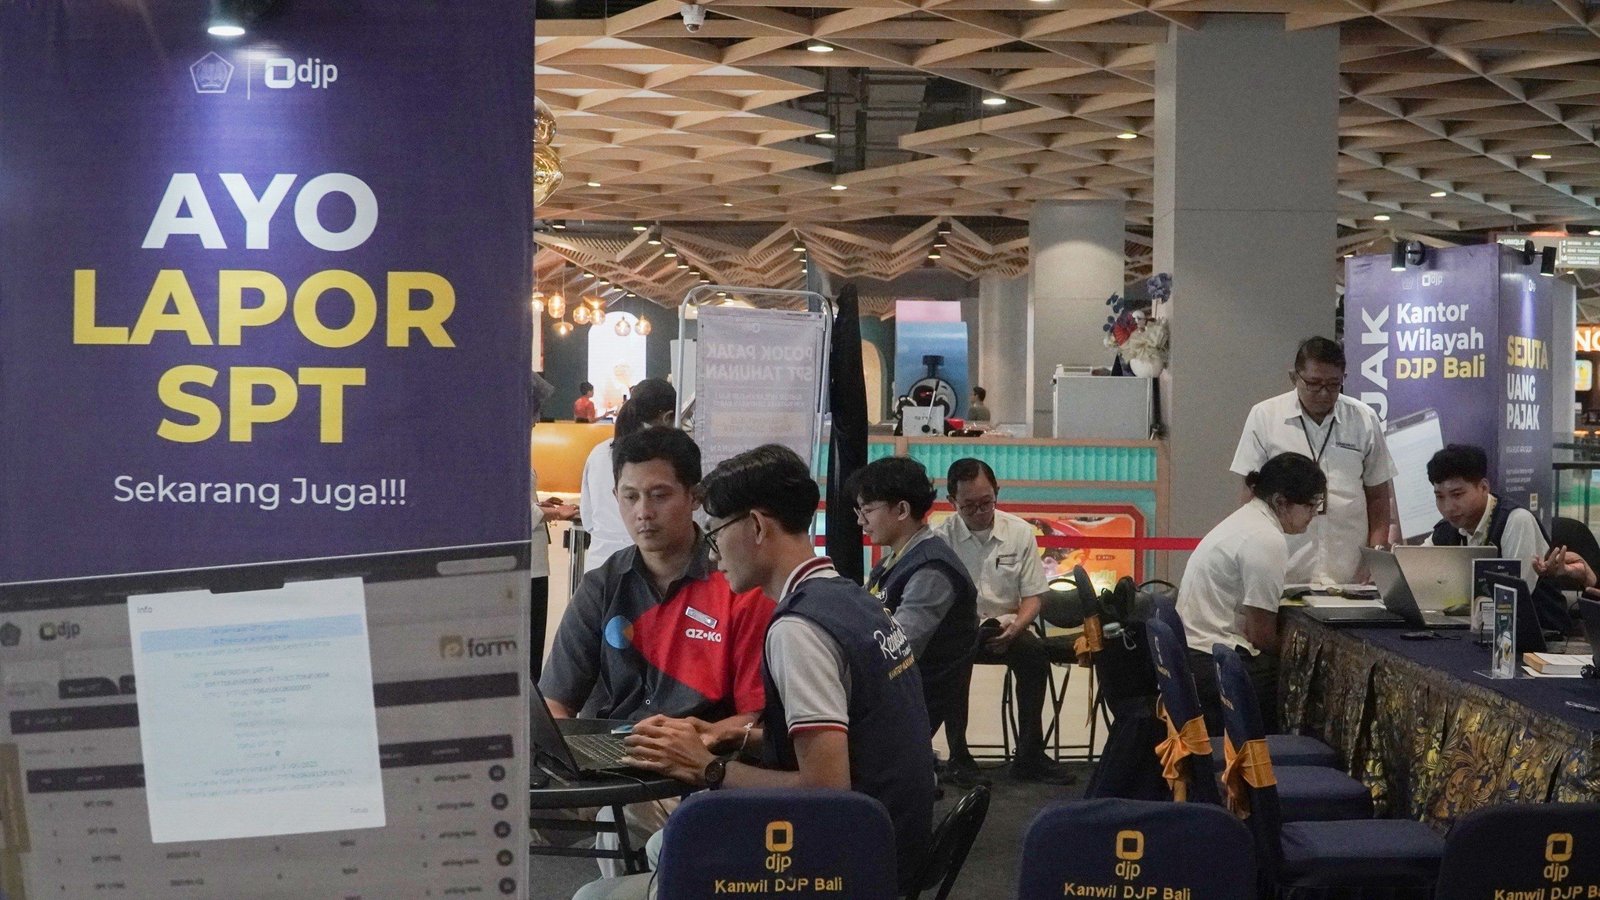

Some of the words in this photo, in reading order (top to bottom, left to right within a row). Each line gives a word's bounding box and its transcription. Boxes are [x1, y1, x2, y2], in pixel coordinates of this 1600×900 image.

[297, 58, 339, 88] djp
[141, 172, 379, 252] AYO
[73, 269, 456, 348] LAPOR
[1397, 302, 1469, 324] Kantor
[1396, 327, 1484, 356] Wilayah
[1507, 335, 1549, 370] SEJUTA
[1396, 357, 1437, 379] DJP
[1443, 354, 1485, 379] Bali
[1506, 373, 1536, 402] UANG
[156, 365, 366, 444] SPT
[1506, 403, 1540, 430] PAJAK
[114, 476, 280, 510] Sekarang
[291, 477, 406, 512] Juga!!!
[56, 621, 80, 640] djp
[765, 853, 792, 873] djp
[1115, 861, 1141, 880] djp
[1543, 863, 1569, 882] djp
[715, 879, 768, 894] Kanwil
[775, 878, 809, 892] DJP
[815, 876, 843, 892] Bali
[1064, 882, 1117, 898] Kanwil
[1123, 885, 1158, 900] DJP
[1163, 887, 1191, 900] Bali
[1494, 888, 1545, 900] Kanwil
[1551, 886, 1583, 899] DJP
